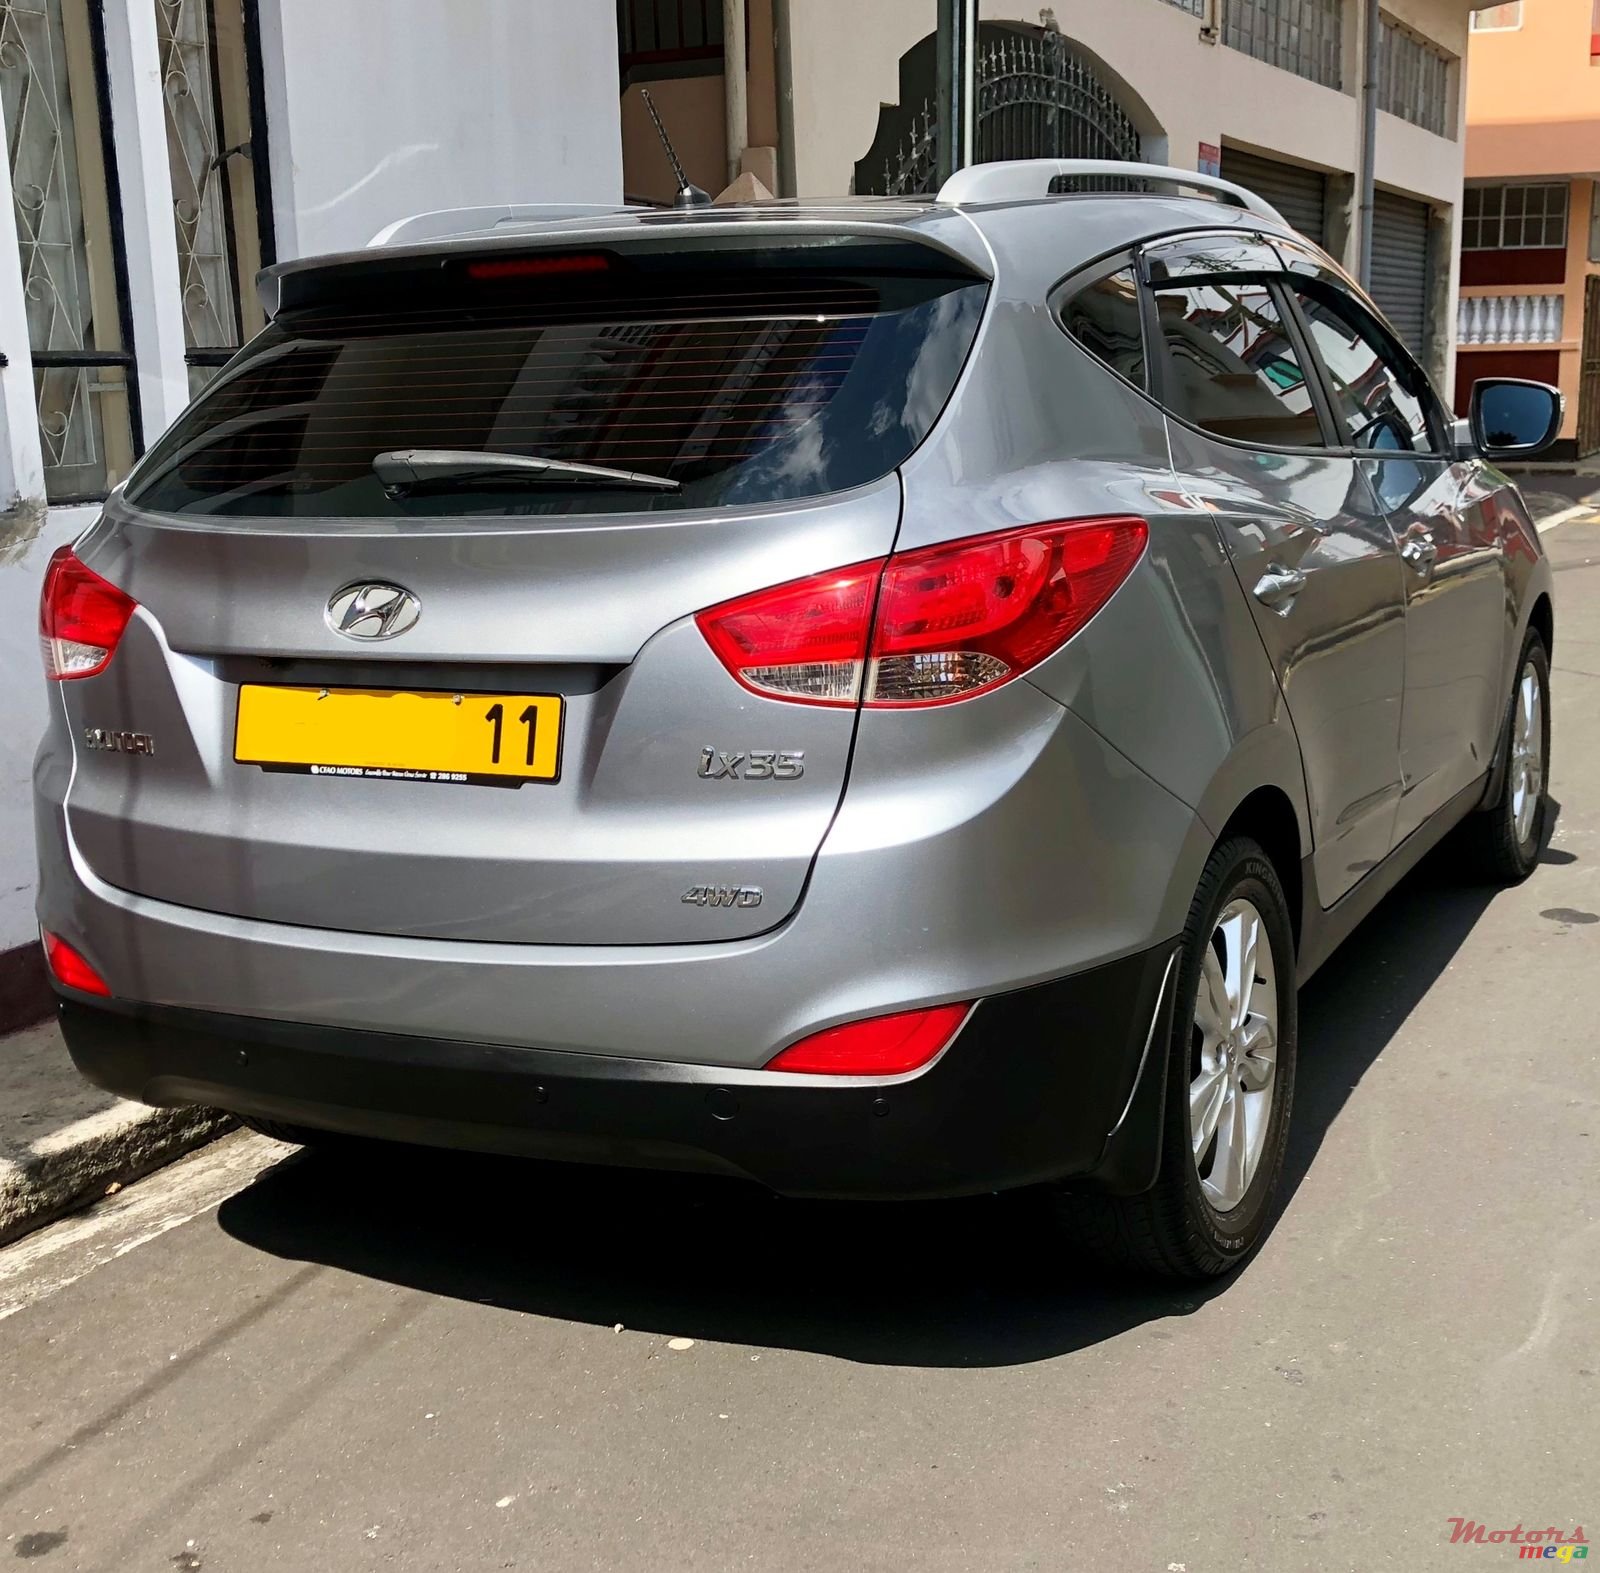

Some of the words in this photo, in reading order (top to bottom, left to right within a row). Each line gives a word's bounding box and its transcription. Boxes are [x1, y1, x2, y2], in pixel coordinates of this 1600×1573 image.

[485, 703, 539, 766] 11
[319, 766, 336, 774] CFAO
[336, 767, 363, 776] MOTORS
[697, 745, 805, 780] ix35
[681, 884, 763, 908] 4WD
